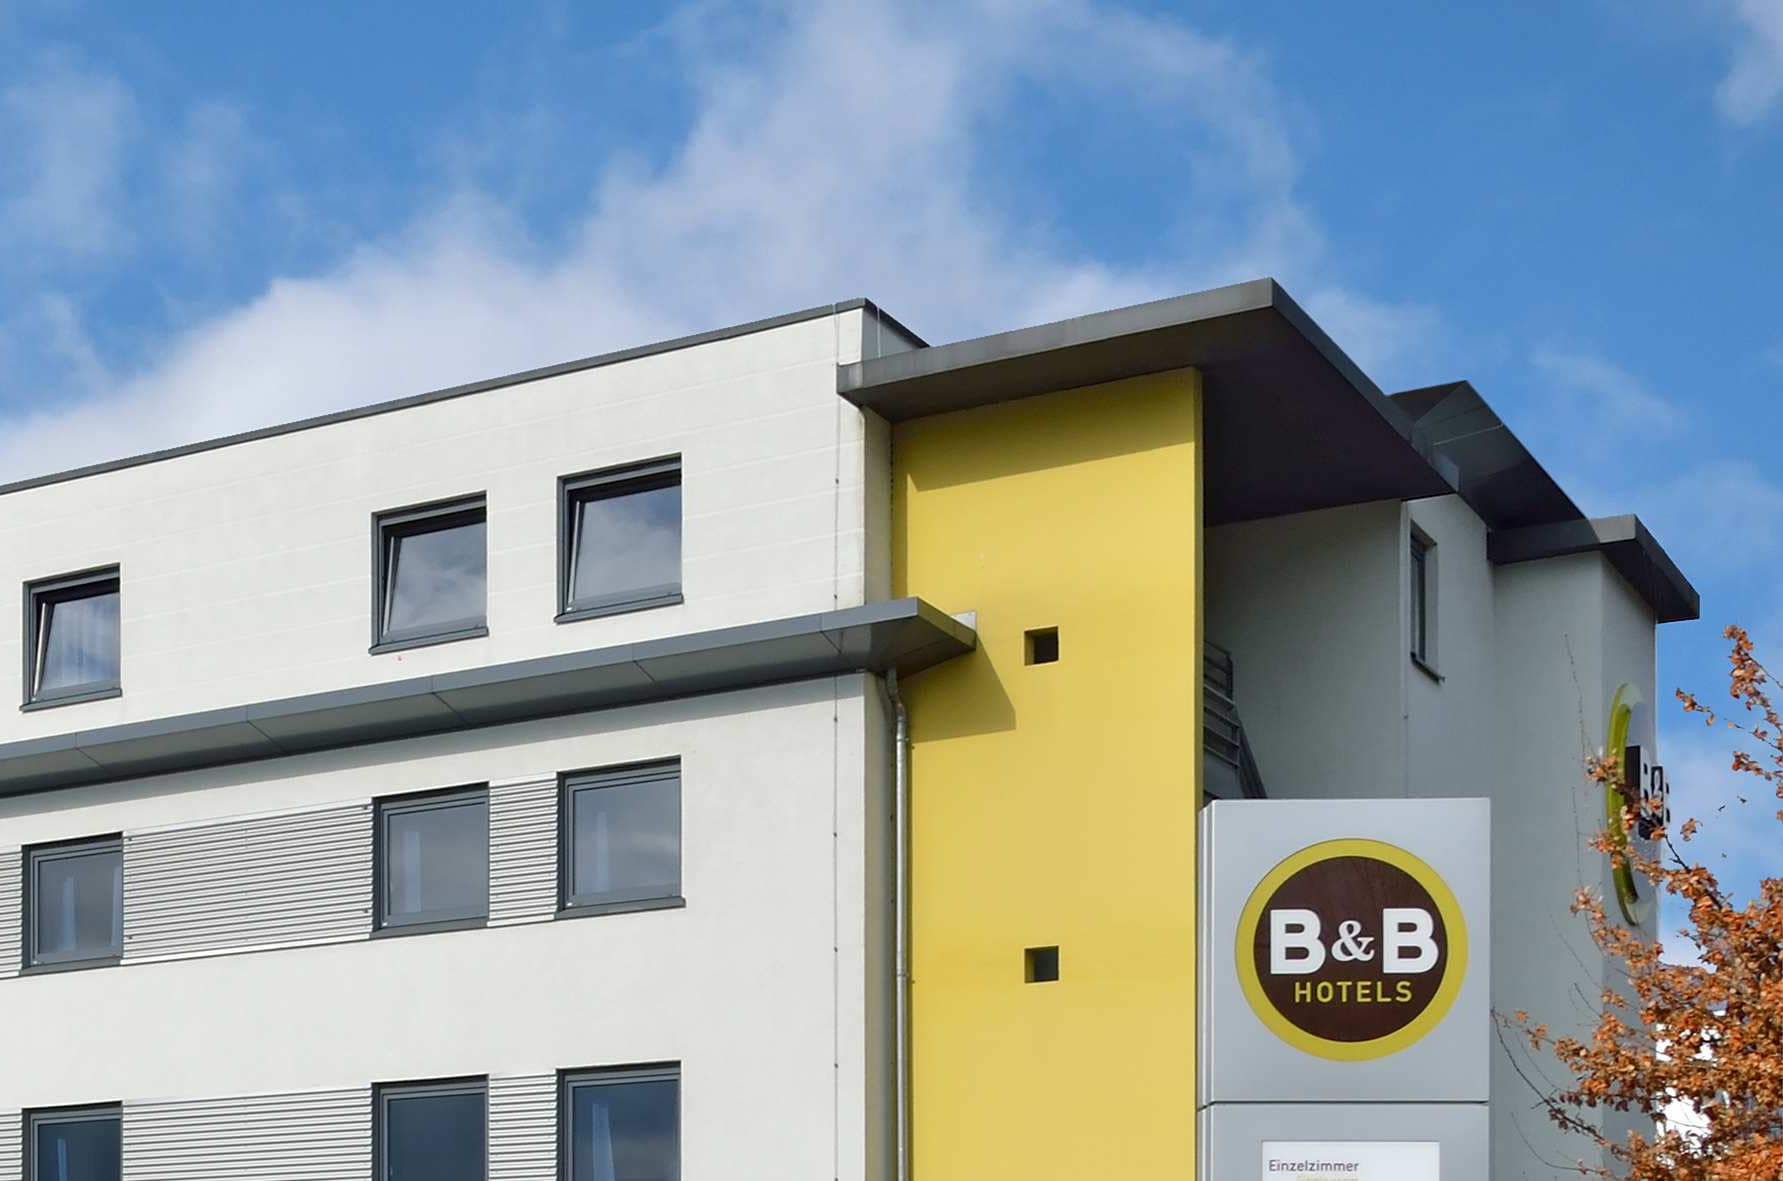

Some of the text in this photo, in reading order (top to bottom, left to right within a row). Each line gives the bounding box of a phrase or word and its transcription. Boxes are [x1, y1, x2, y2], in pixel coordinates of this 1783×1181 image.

[1270, 908, 1439, 974] B&B
[1294, 981, 1413, 1003] HOTELS
[1269, 1160, 1359, 1171] Einzelzimmer
